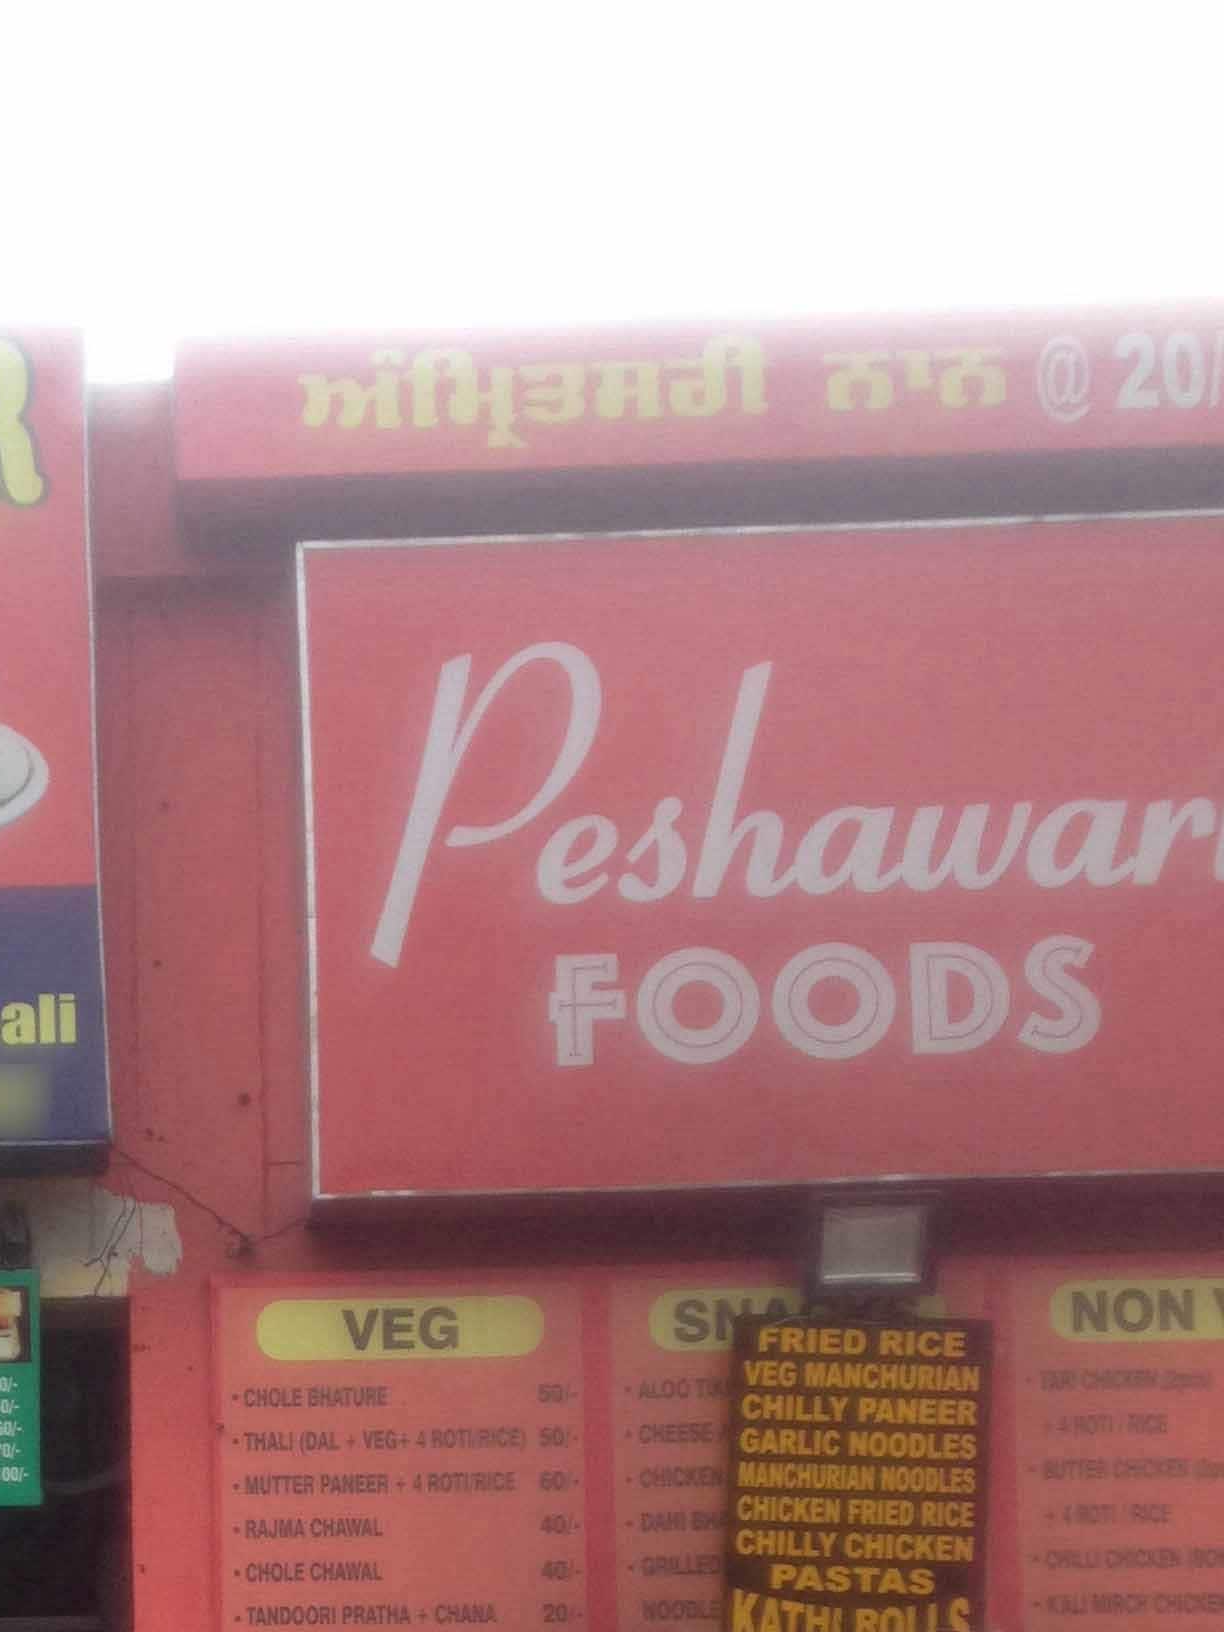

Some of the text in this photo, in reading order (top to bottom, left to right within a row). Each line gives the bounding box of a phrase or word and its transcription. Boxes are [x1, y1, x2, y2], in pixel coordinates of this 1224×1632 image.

[823, 347, 1008, 414] ਨਾਨ
[548, 934, 1102, 1066] FOODS
[1072, 1288, 1195, 1333] NON
[342, 1306, 460, 1351] VEG
[758, 1327, 967, 1357] FRIED RICE
[744, 1360, 981, 1391] VEG MANCHURIAN
[243, 1387, 303, 1408] CHOLE
[306, 1385, 388, 1408] BHATURE
[741, 1393, 978, 1425] CHILLY PANEER
[244, 1431, 294, 1452] THALI
[739, 1427, 977, 1460] GARLIC NOODLES
[244, 1474, 314, 1496] MUTTER
[319, 1473, 389, 1495] PANEER
[737, 1461, 976, 1494] MANCHURIAN NOODLES
[736, 1495, 841, 1523] CHICKEN
[847, 1499, 915, 1527] FRIED
[921, 1501, 976, 1528] RICE
[245, 1518, 305, 1539] RAJMA
[310, 1517, 383, 1538] CHAWAL
[736, 1529, 974, 1562] CHILLY CHICKEN
[245, 1562, 305, 1583] CHOLE
[310, 1560, 383, 1582] CHAWAL
[769, 1563, 935, 1595] PASTAS
[247, 1605, 336, 1626] TANDOORI
[342, 1604, 411, 1625] PRATHA
[434, 1602, 497, 1624] CHANA
